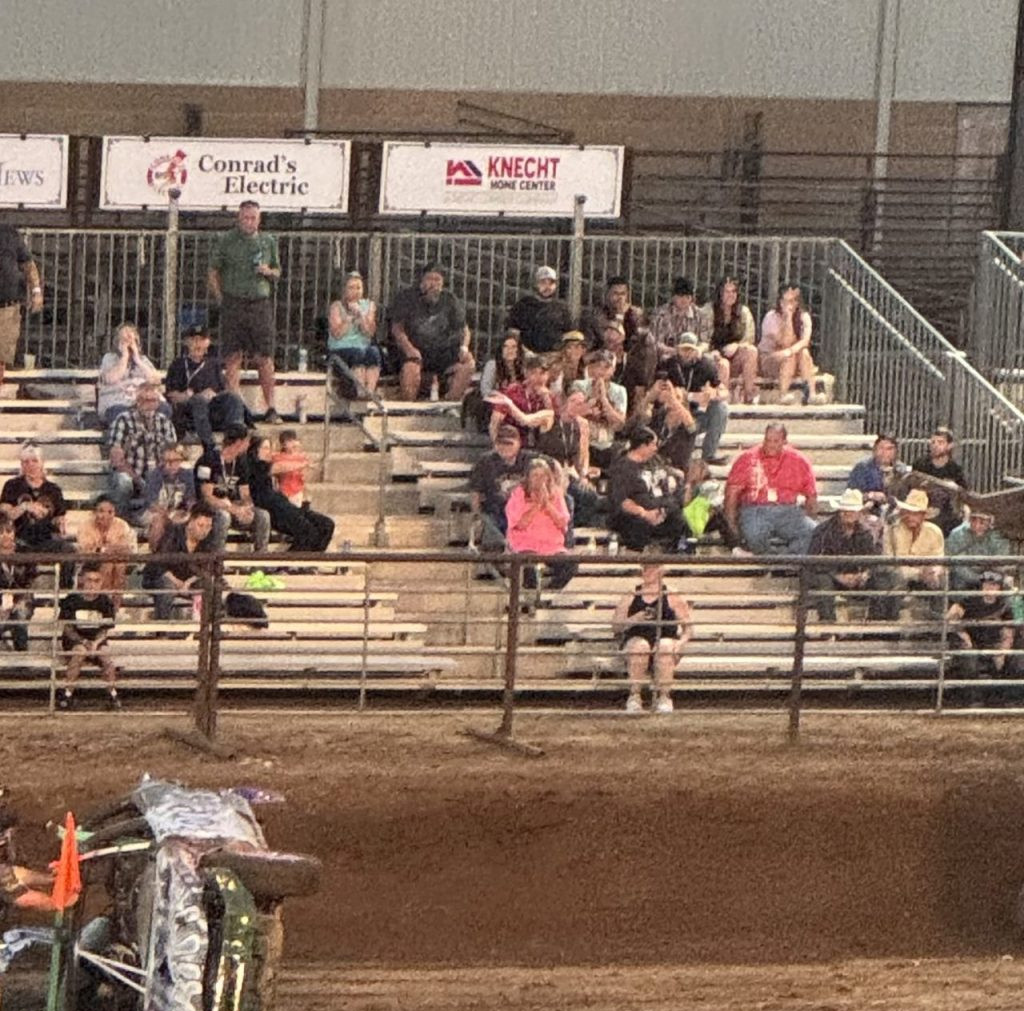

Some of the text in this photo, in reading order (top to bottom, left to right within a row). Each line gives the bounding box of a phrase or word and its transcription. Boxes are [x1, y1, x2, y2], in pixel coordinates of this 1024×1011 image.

[198, 154, 297, 174] Conrad's
[487, 155, 561, 178] KNECHT
[224, 175, 309, 195] Electric
[490, 180, 556, 190] HOME CENTER
